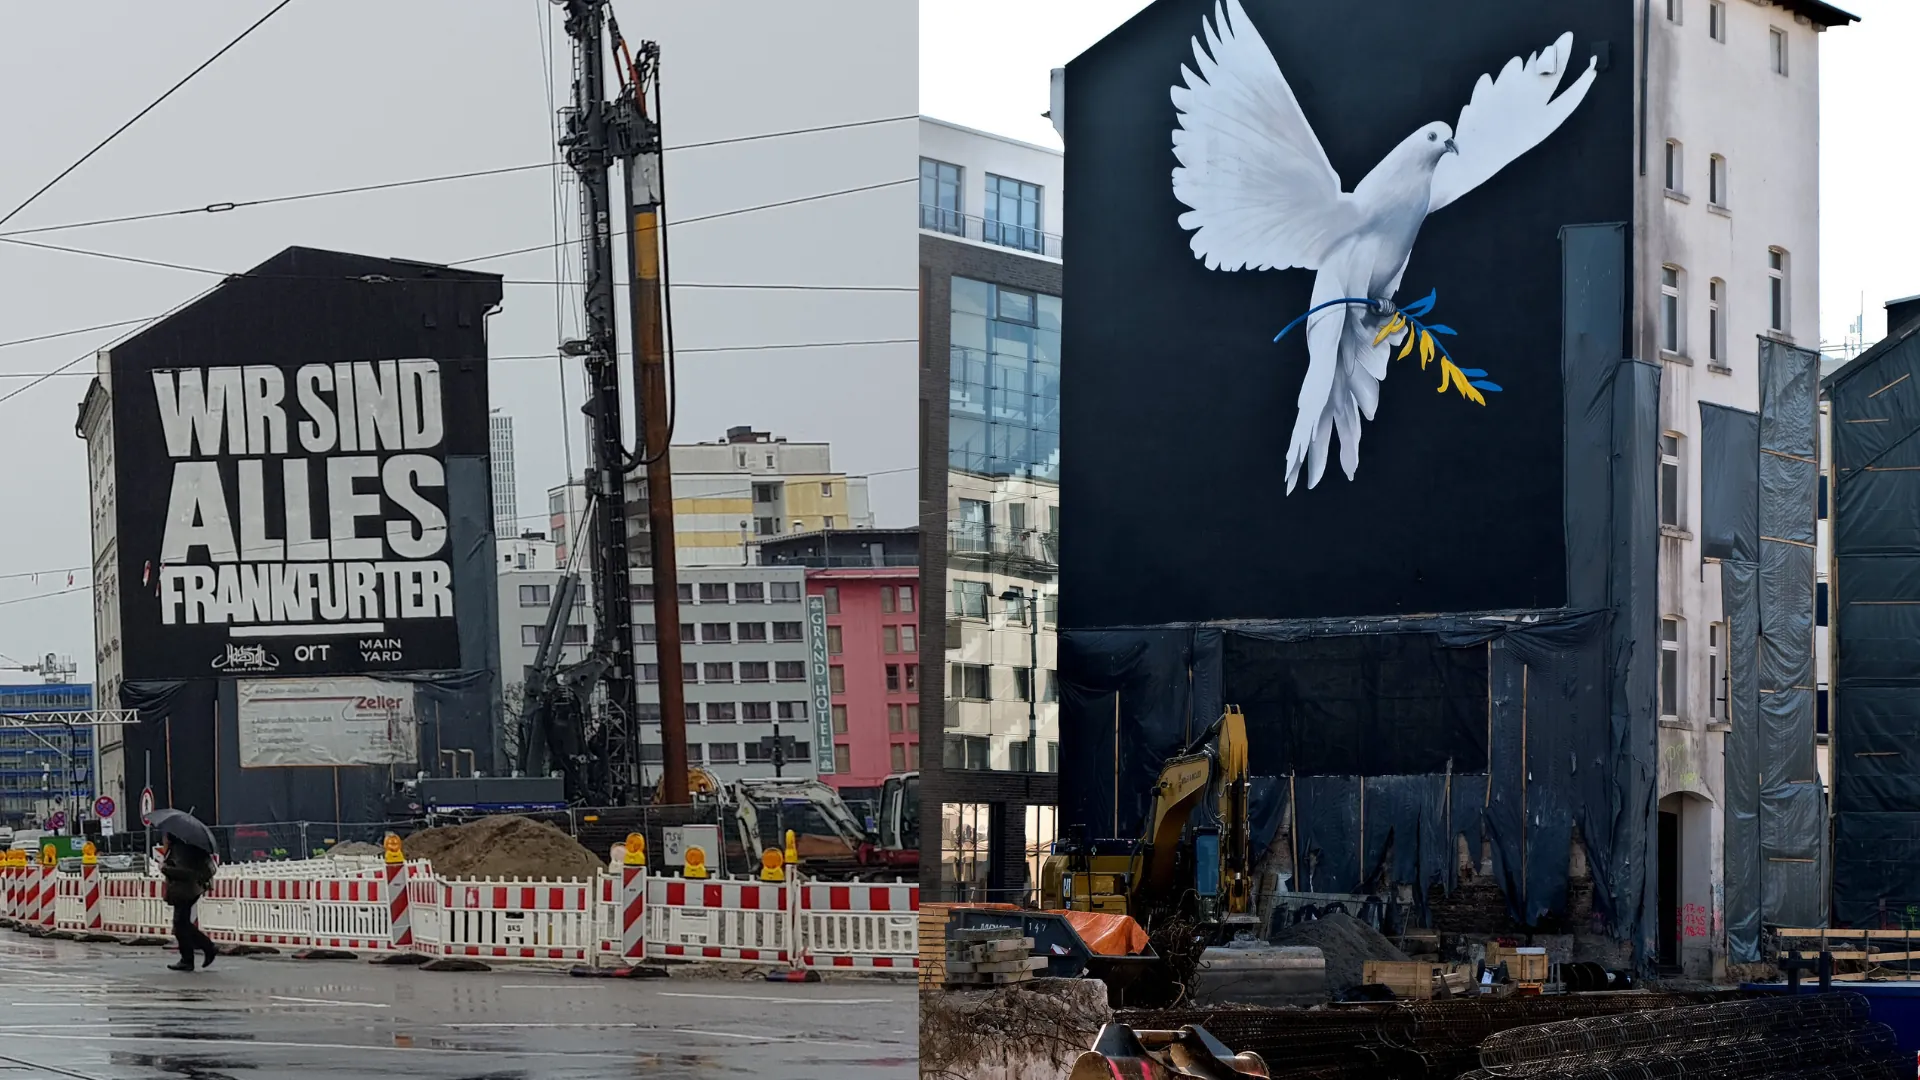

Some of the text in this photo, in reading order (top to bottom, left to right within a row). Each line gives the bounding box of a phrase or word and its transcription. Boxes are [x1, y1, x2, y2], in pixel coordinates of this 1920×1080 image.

[152, 357, 444, 457] WIR SIND
[160, 453, 447, 563] ALLES
[160, 560, 453, 624] FRANKFURTER
[360, 638, 401, 649] MAIN
[361, 651, 402, 662] YARD
[355, 695, 403, 709] Zeller
[811, 612, 829, 748] GRAND HOTEL
